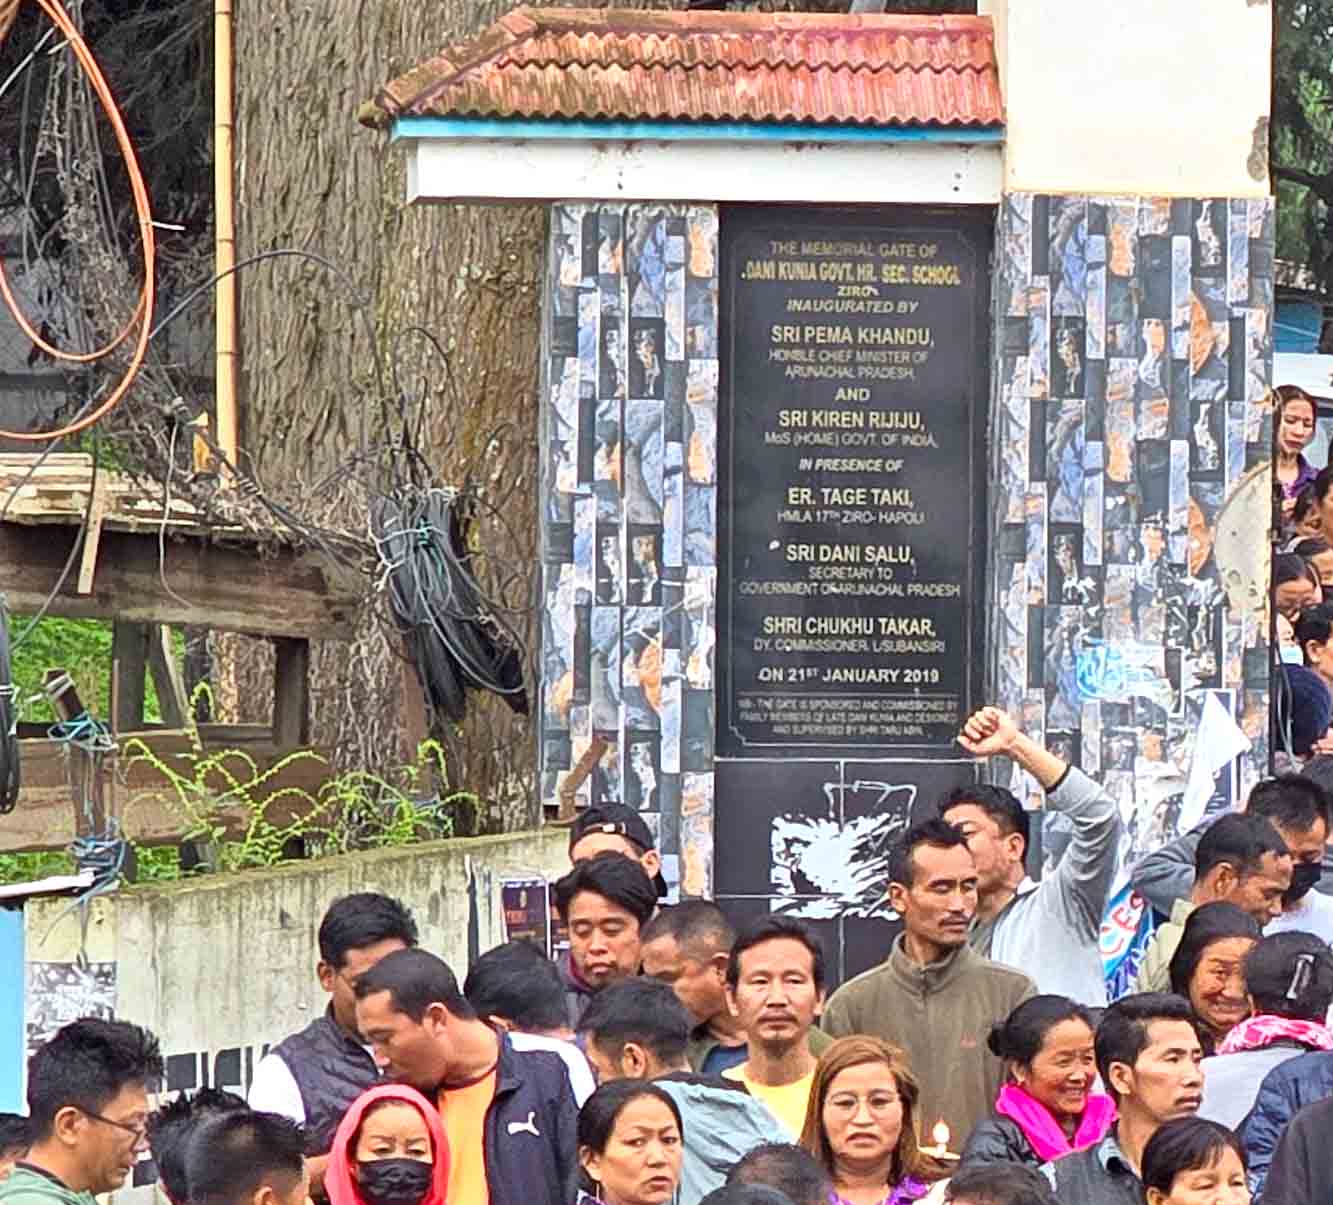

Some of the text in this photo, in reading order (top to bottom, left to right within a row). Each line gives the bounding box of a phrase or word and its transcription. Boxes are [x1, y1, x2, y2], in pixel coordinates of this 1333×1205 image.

[880, 243, 916, 257] GATE
[919, 244, 937, 258] OF
[787, 299, 919, 313] INAUGURATED BY
[771, 325, 935, 347] SRI PEMA KHANDU,
[856, 351, 909, 363] MINISTER
[912, 351, 928, 363] OF
[835, 388, 871, 401] AND
[779, 410, 807, 427] SRI
[812, 410, 864, 428] KIREN
[881, 433, 898, 446] OF
[799, 458, 904, 472] IN PRESENCE OF
[788, 488, 914, 508] ER. TAGE TAKI,
[787, 544, 916, 566] SRI DANI SALU,
[808, 566, 893, 580] SECRETARY TO
[740, 582, 818, 595] GOVERNMENT
[907, 584, 960, 597] PRADESH
[764, 616, 802, 634] SHRI
[806, 617, 873, 635] CHUKHU
[759, 667, 940, 683] ON 21ST JANUARY 2019
